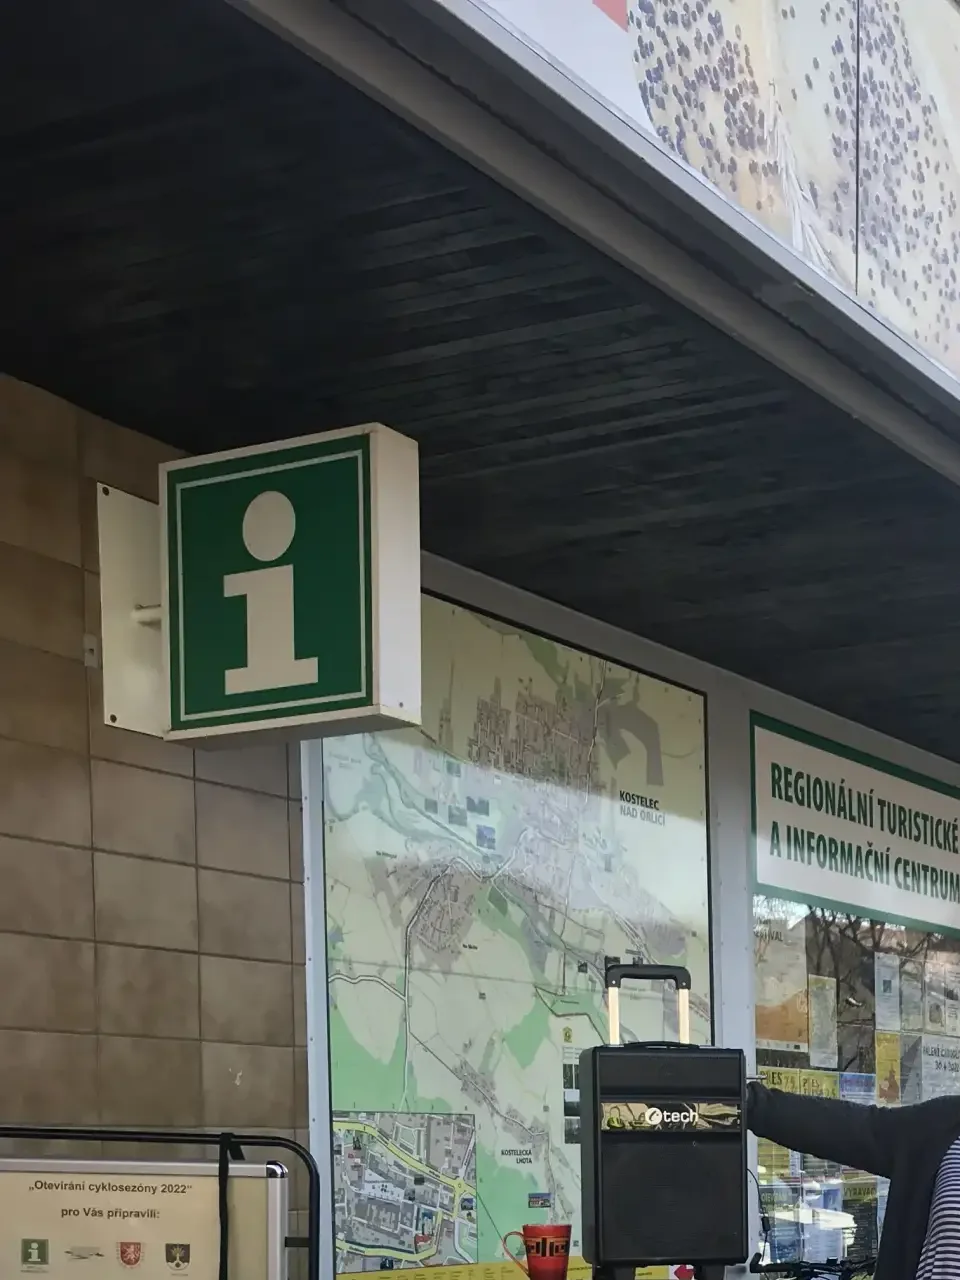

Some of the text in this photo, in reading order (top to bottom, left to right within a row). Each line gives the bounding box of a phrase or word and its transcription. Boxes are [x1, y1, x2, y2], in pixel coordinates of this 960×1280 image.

[619, 790, 660, 811] KOSTELEC
[770, 762, 959, 854] REGIONÁLNÍ TURISTICKÉ
[620, 804, 666, 826] NAD ORLICÍ
[769, 821, 960, 904] A INFORMAČNÍ CENTRUM
[88, 1182, 157, 1194] cyklosezóny
[61, 1208, 80, 1218] pro
[83, 1207, 104, 1217] Vás
